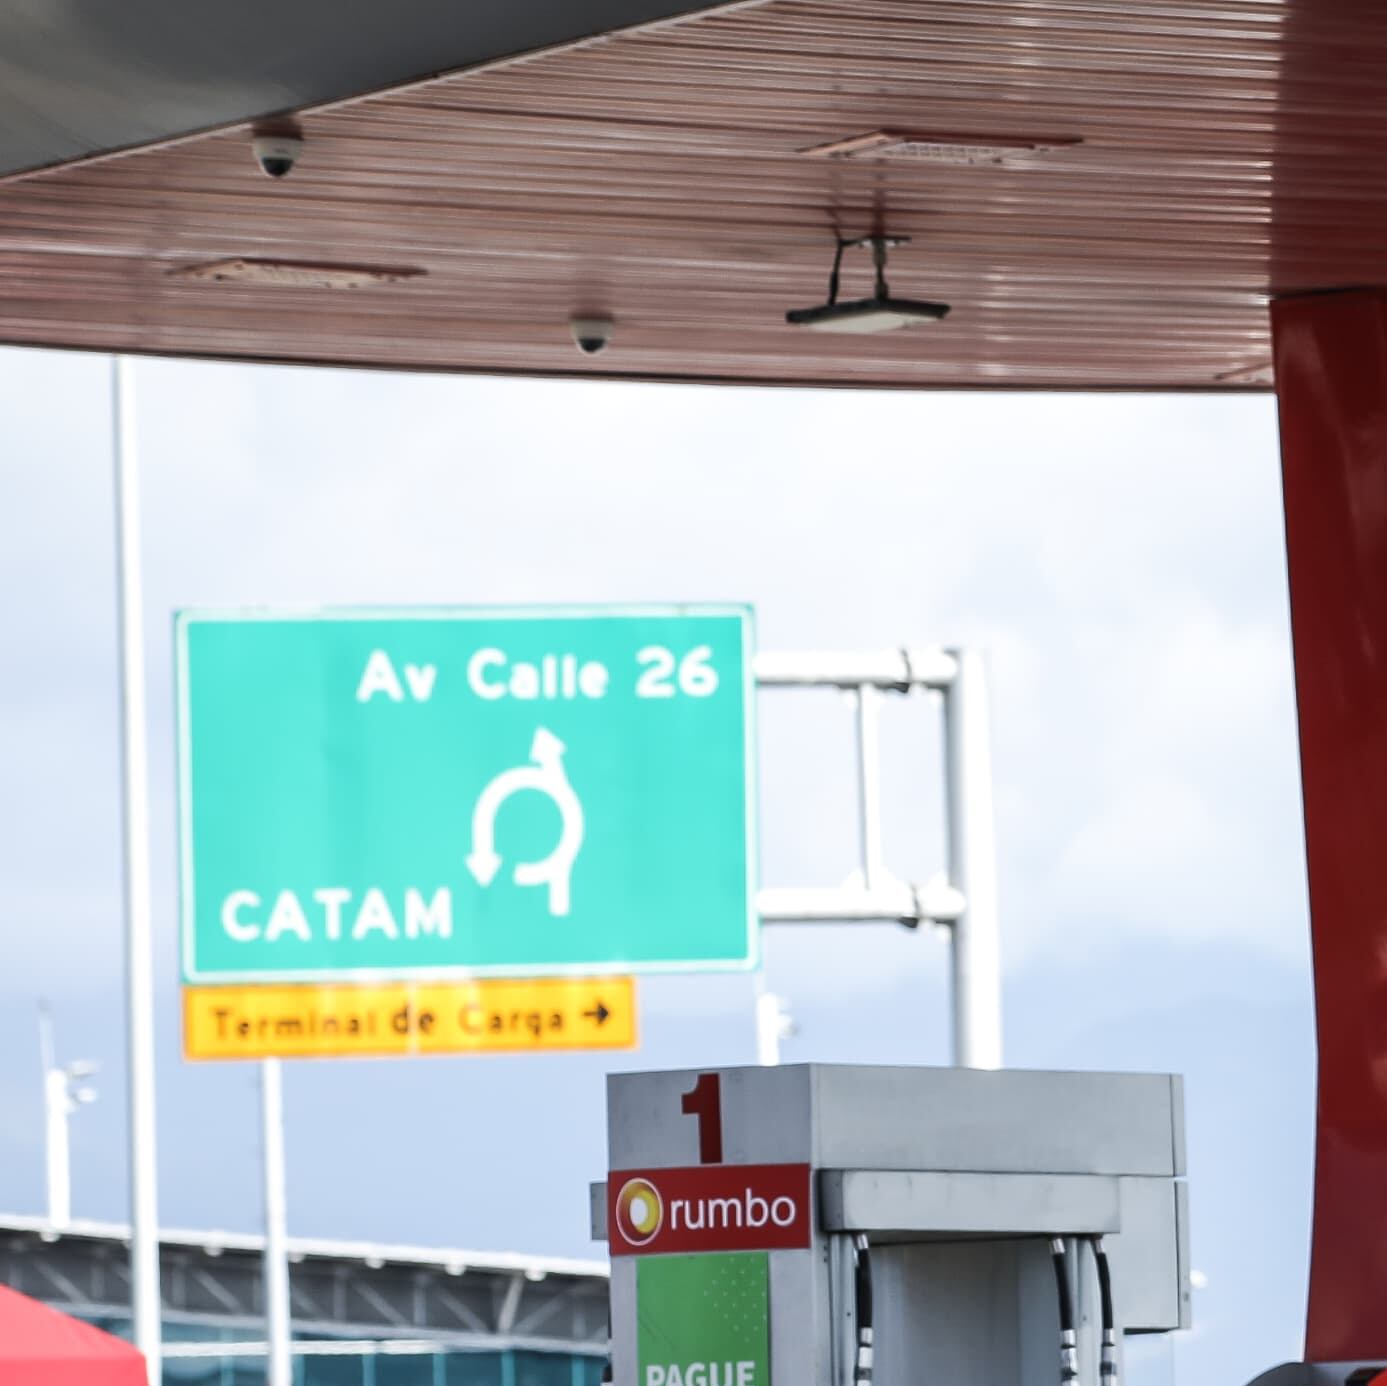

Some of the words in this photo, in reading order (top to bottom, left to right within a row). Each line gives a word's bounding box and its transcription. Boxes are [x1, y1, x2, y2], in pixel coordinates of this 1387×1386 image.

[357, 650, 436, 702] Av
[467, 649, 610, 699] Calle
[635, 646, 718, 697] 26
[221, 887, 453, 942] CATAM
[213, 1009, 377, 1042] Terminal
[391, 1000, 434, 1036] de
[459, 1002, 564, 1036] Carga
[681, 1073, 722, 1163] 1
[671, 1189, 796, 1230] rumbo
